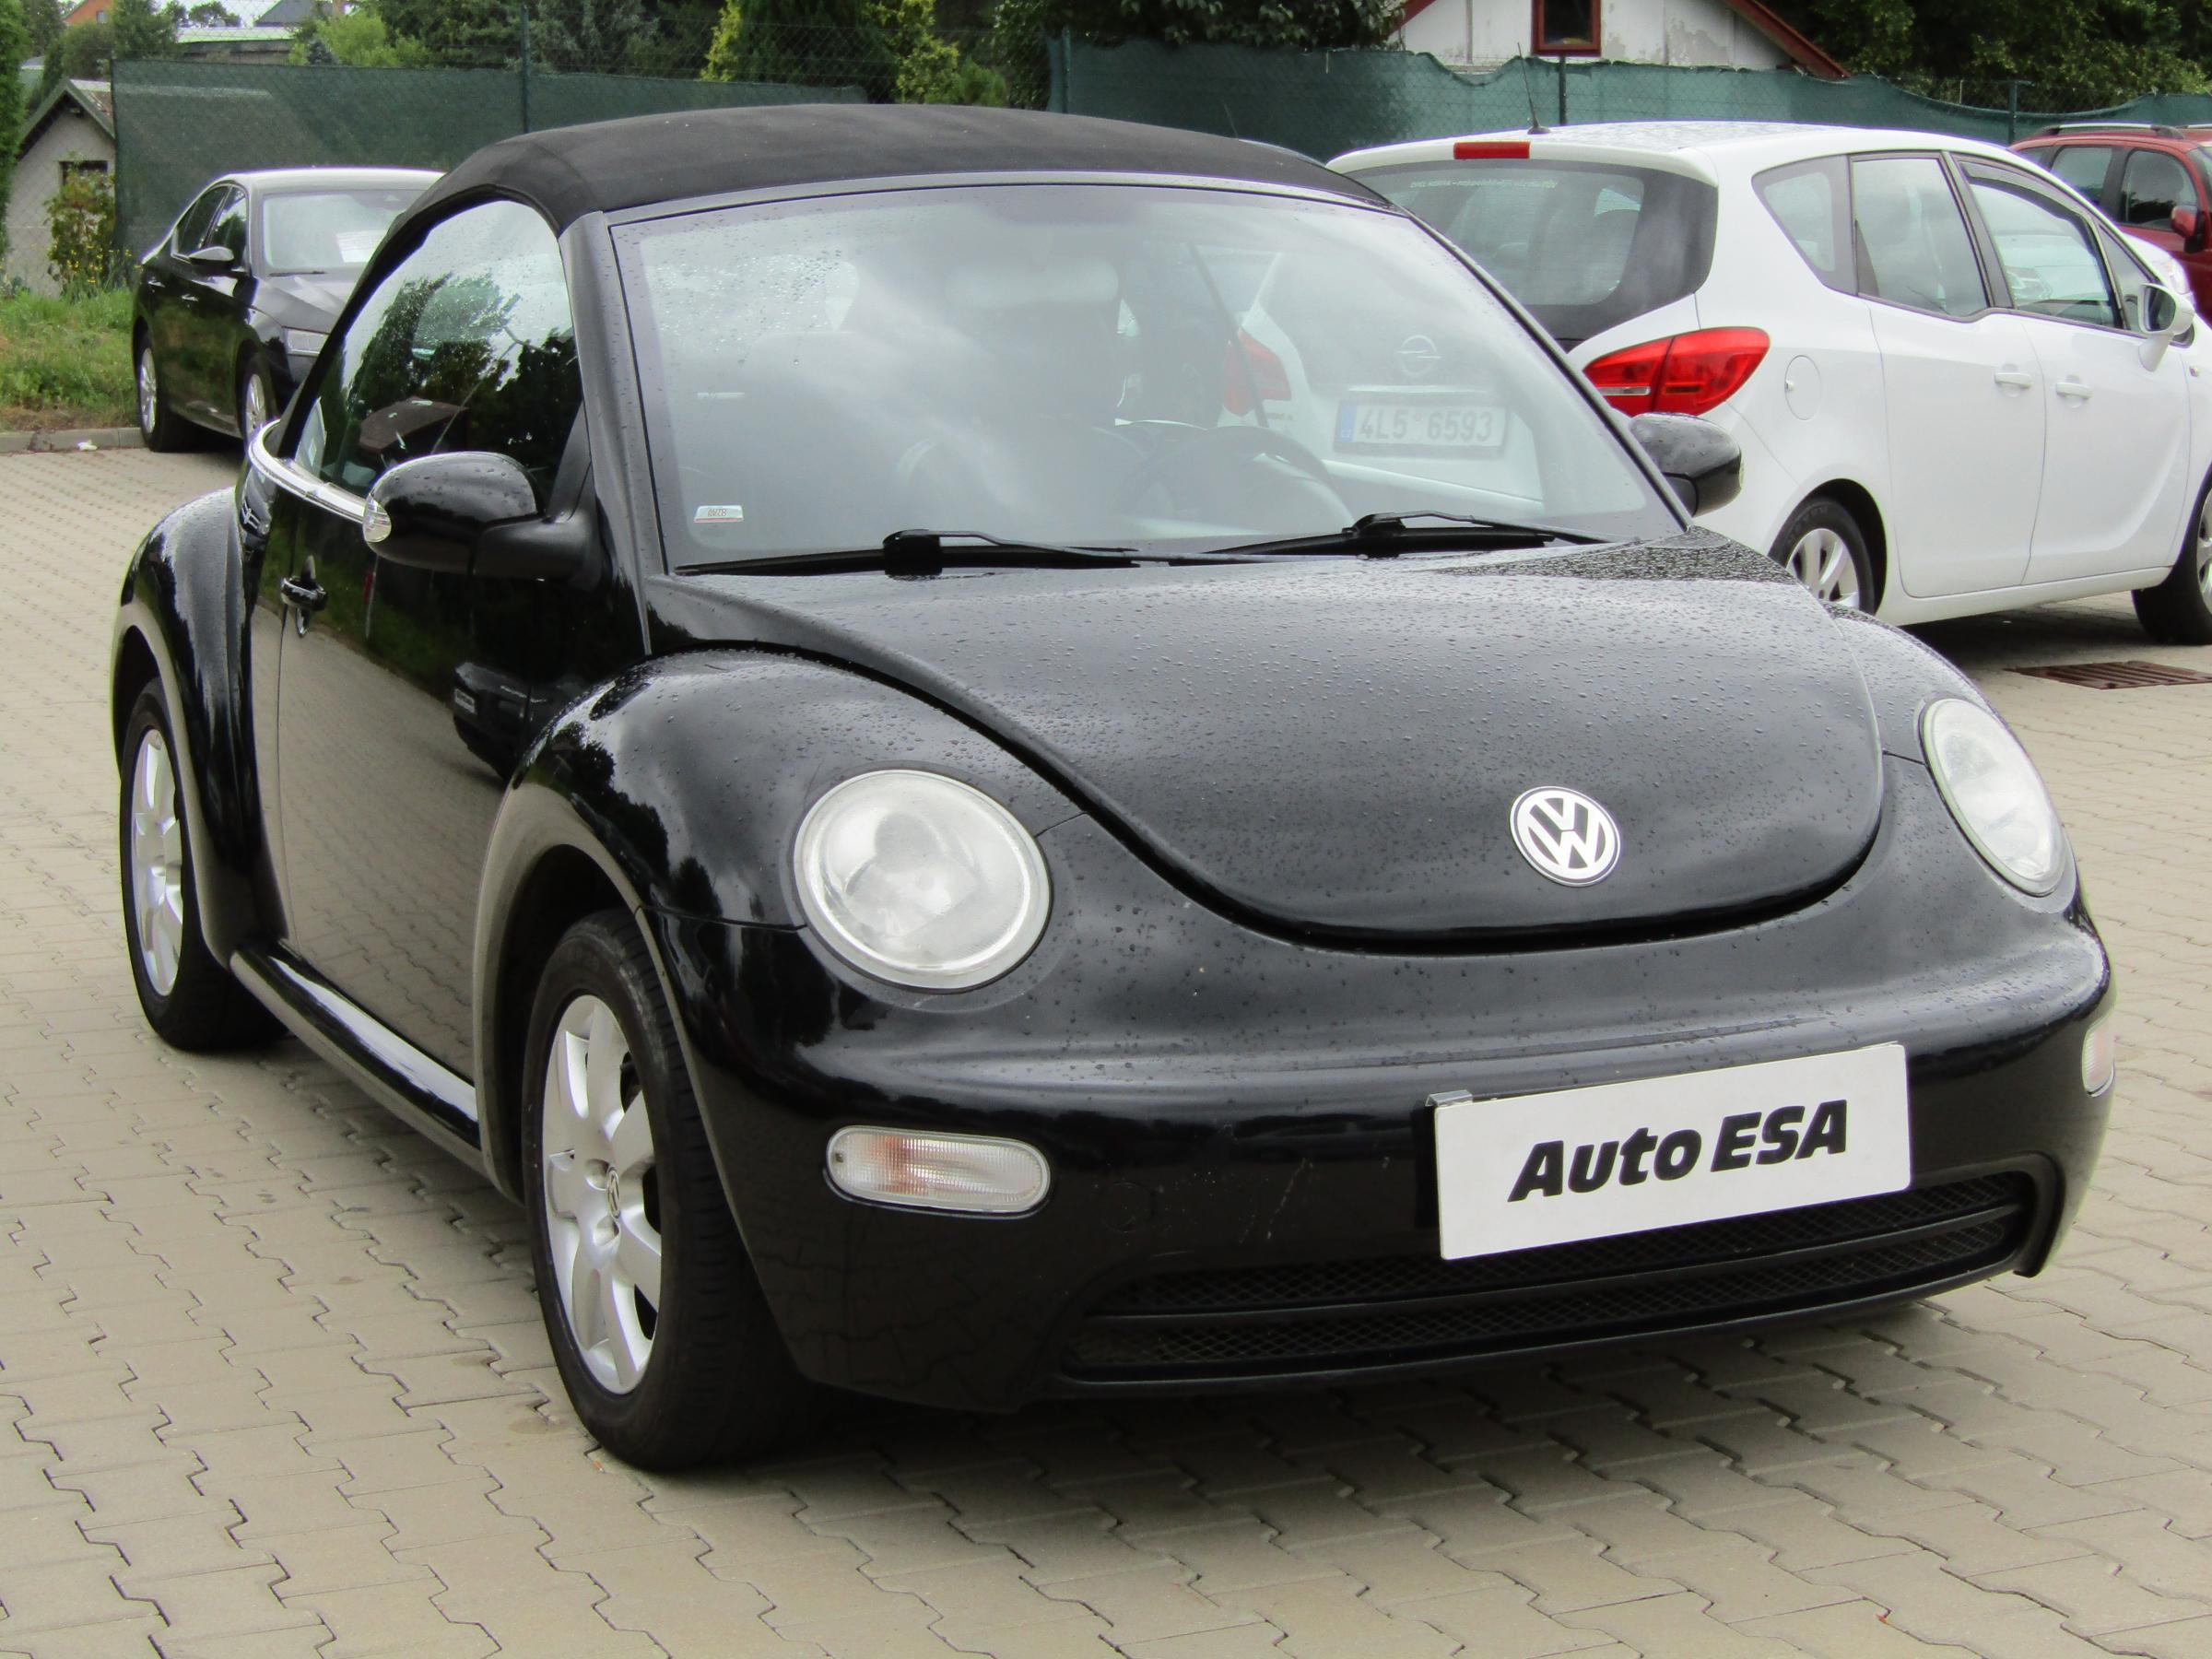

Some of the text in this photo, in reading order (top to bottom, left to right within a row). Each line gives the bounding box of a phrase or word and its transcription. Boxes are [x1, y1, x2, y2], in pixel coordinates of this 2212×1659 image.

[1359, 408, 1492, 442] 4L5 6593
[1517, 790, 1616, 879] VW
[1507, 1100, 1847, 1202] Auto ESA
